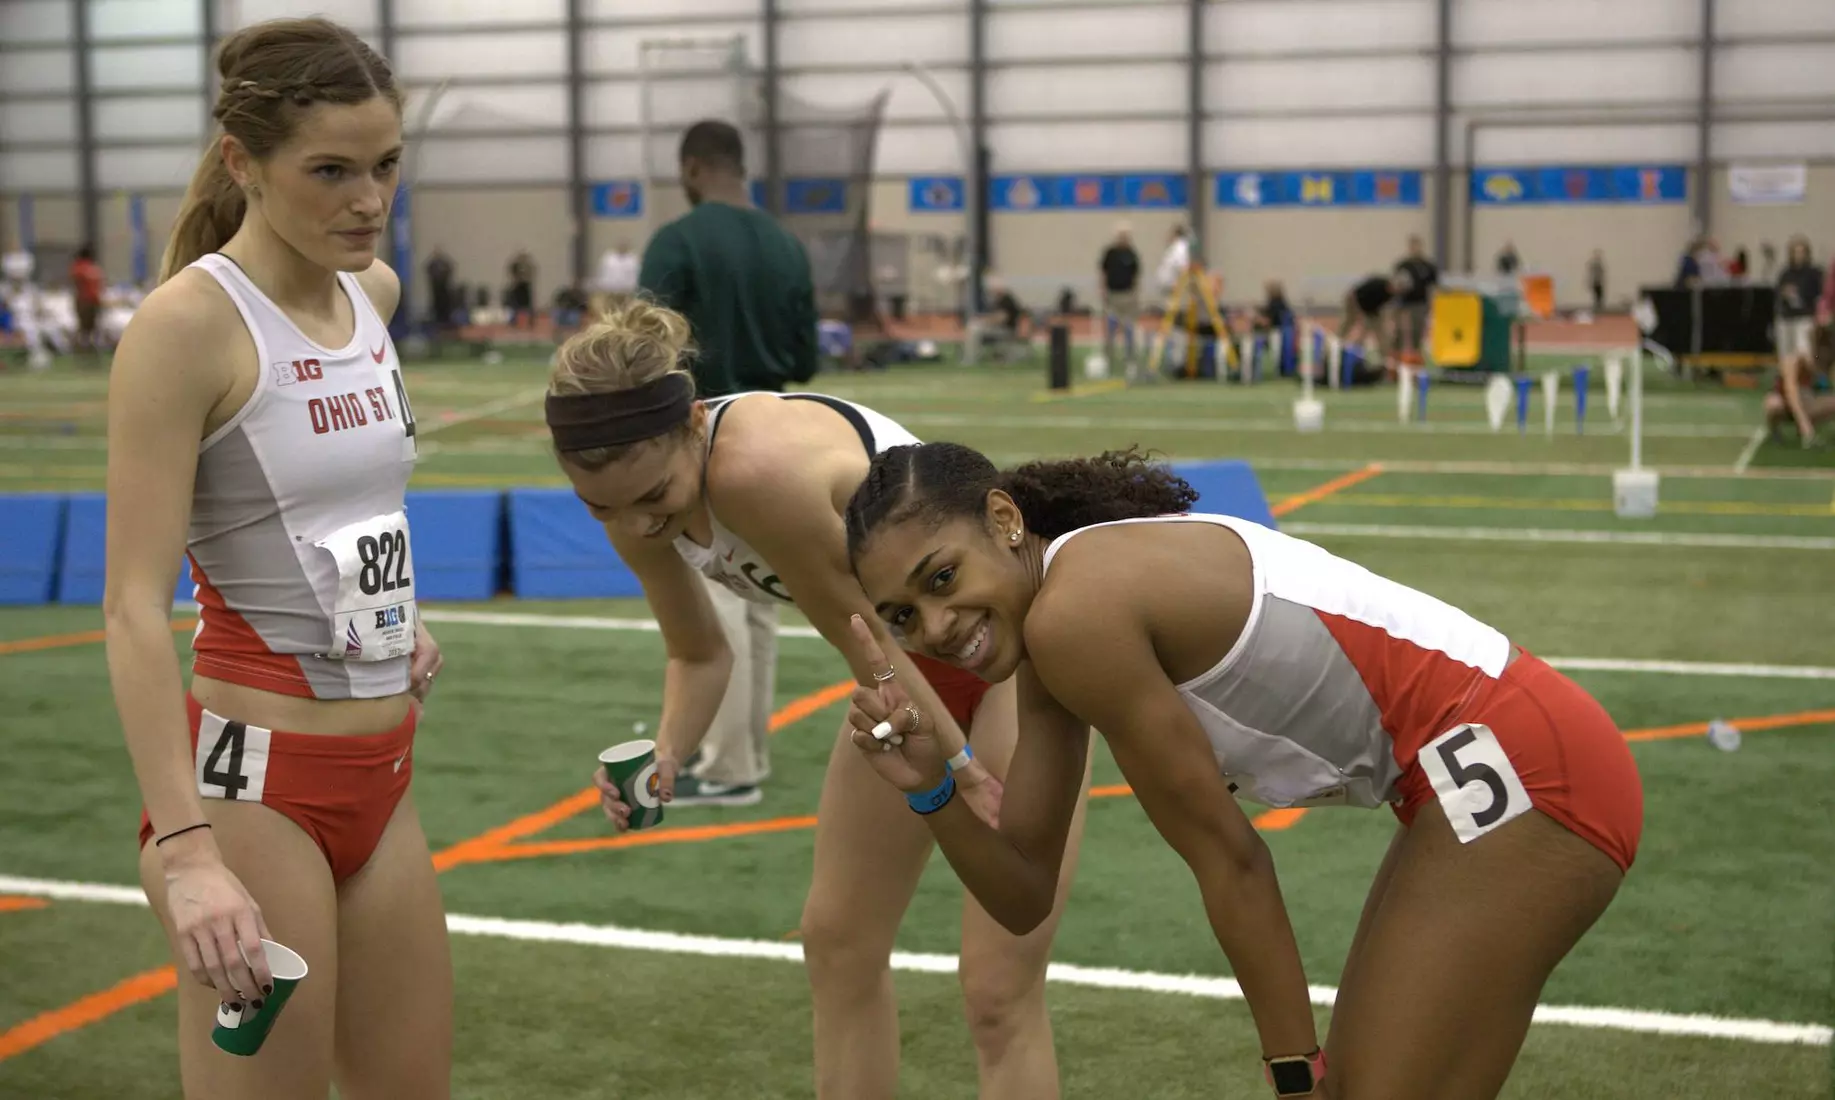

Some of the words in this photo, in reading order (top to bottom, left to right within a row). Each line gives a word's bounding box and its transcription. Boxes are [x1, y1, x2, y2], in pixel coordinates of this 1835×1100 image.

[307, 391, 368, 435] OHIO
[356, 529, 410, 596] 822
[740, 562, 794, 602] 6
[203, 720, 249, 800] 4
[1435, 727, 1508, 828] 5
